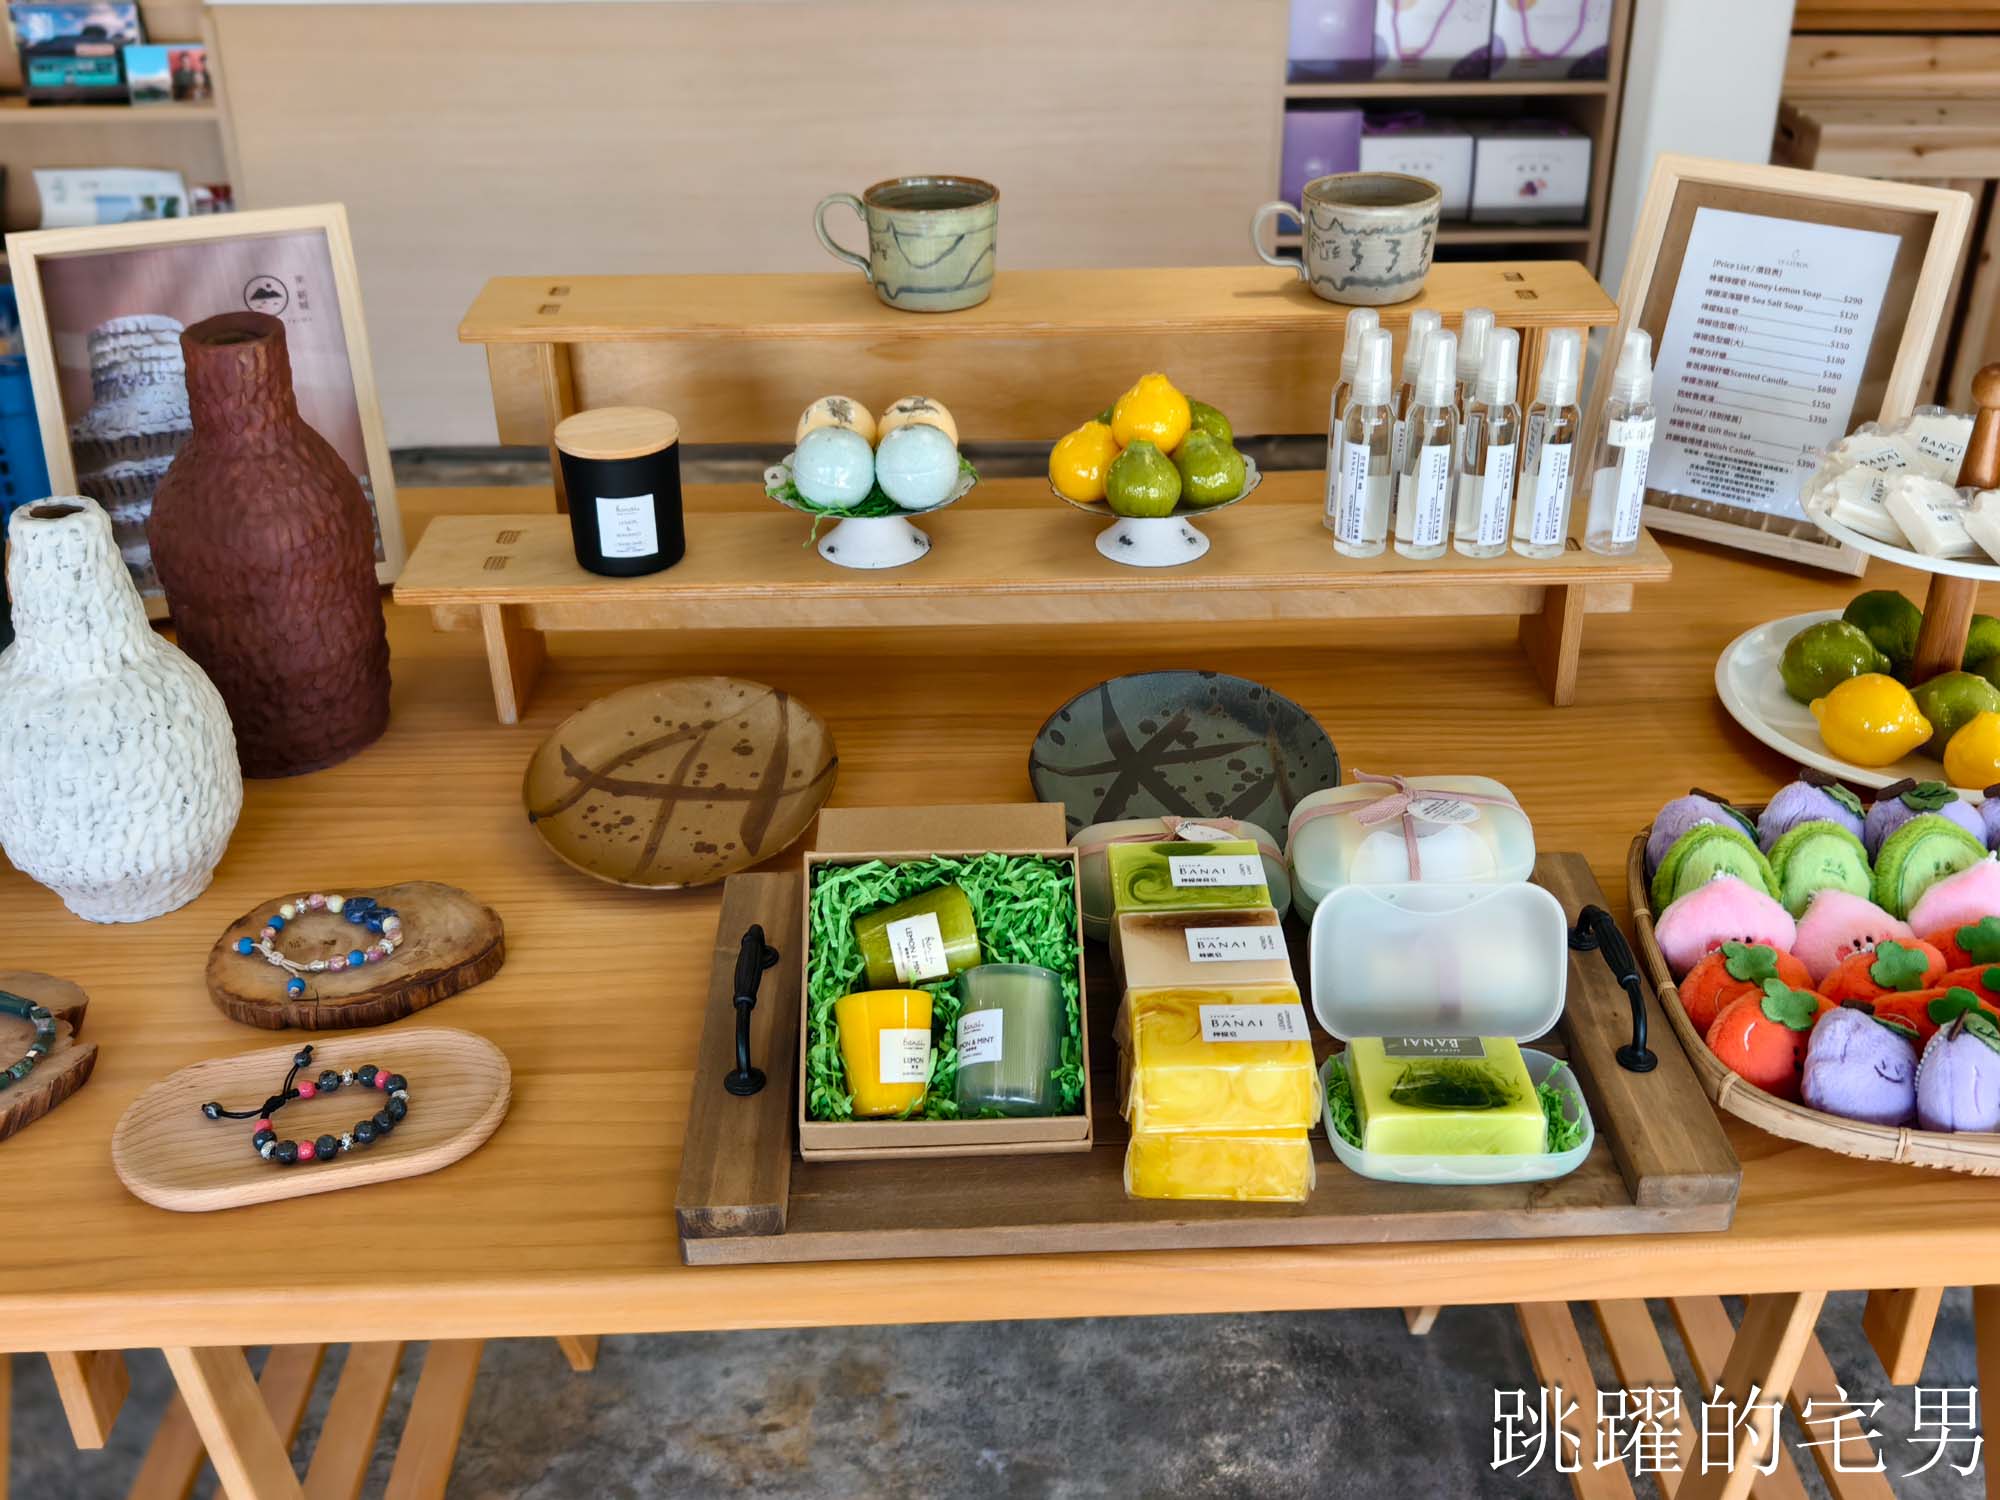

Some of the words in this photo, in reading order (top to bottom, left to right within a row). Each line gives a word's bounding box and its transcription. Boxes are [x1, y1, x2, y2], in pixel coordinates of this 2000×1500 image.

[1748, 281, 1772, 292] Honey
[1774, 284, 1800, 295] Lemon
[1802, 288, 1822, 299] Soap
[1842, 295, 1863, 305] $290
[1752, 296, 1767, 304] Sea
[1767, 298, 1782, 307] Salt
[1783, 301, 1804, 312] Soap
[1839, 310, 1859, 320] $120
[1761, 374, 1789, 386] Candle
[1707, 425, 1722, 435] Gift
[1723, 429, 1737, 438] Box
[1729, 444, 1756, 457] Candle
[1921, 436, 1962, 456] BANAI
[905, 927, 916, 953] LEMON
[1197, 941, 1247, 949] BANAI
[1211, 1019, 1263, 1028] BANAI
[977, 1035, 994, 1044] MINT
[1403, 1038, 1459, 1048] BANAI
